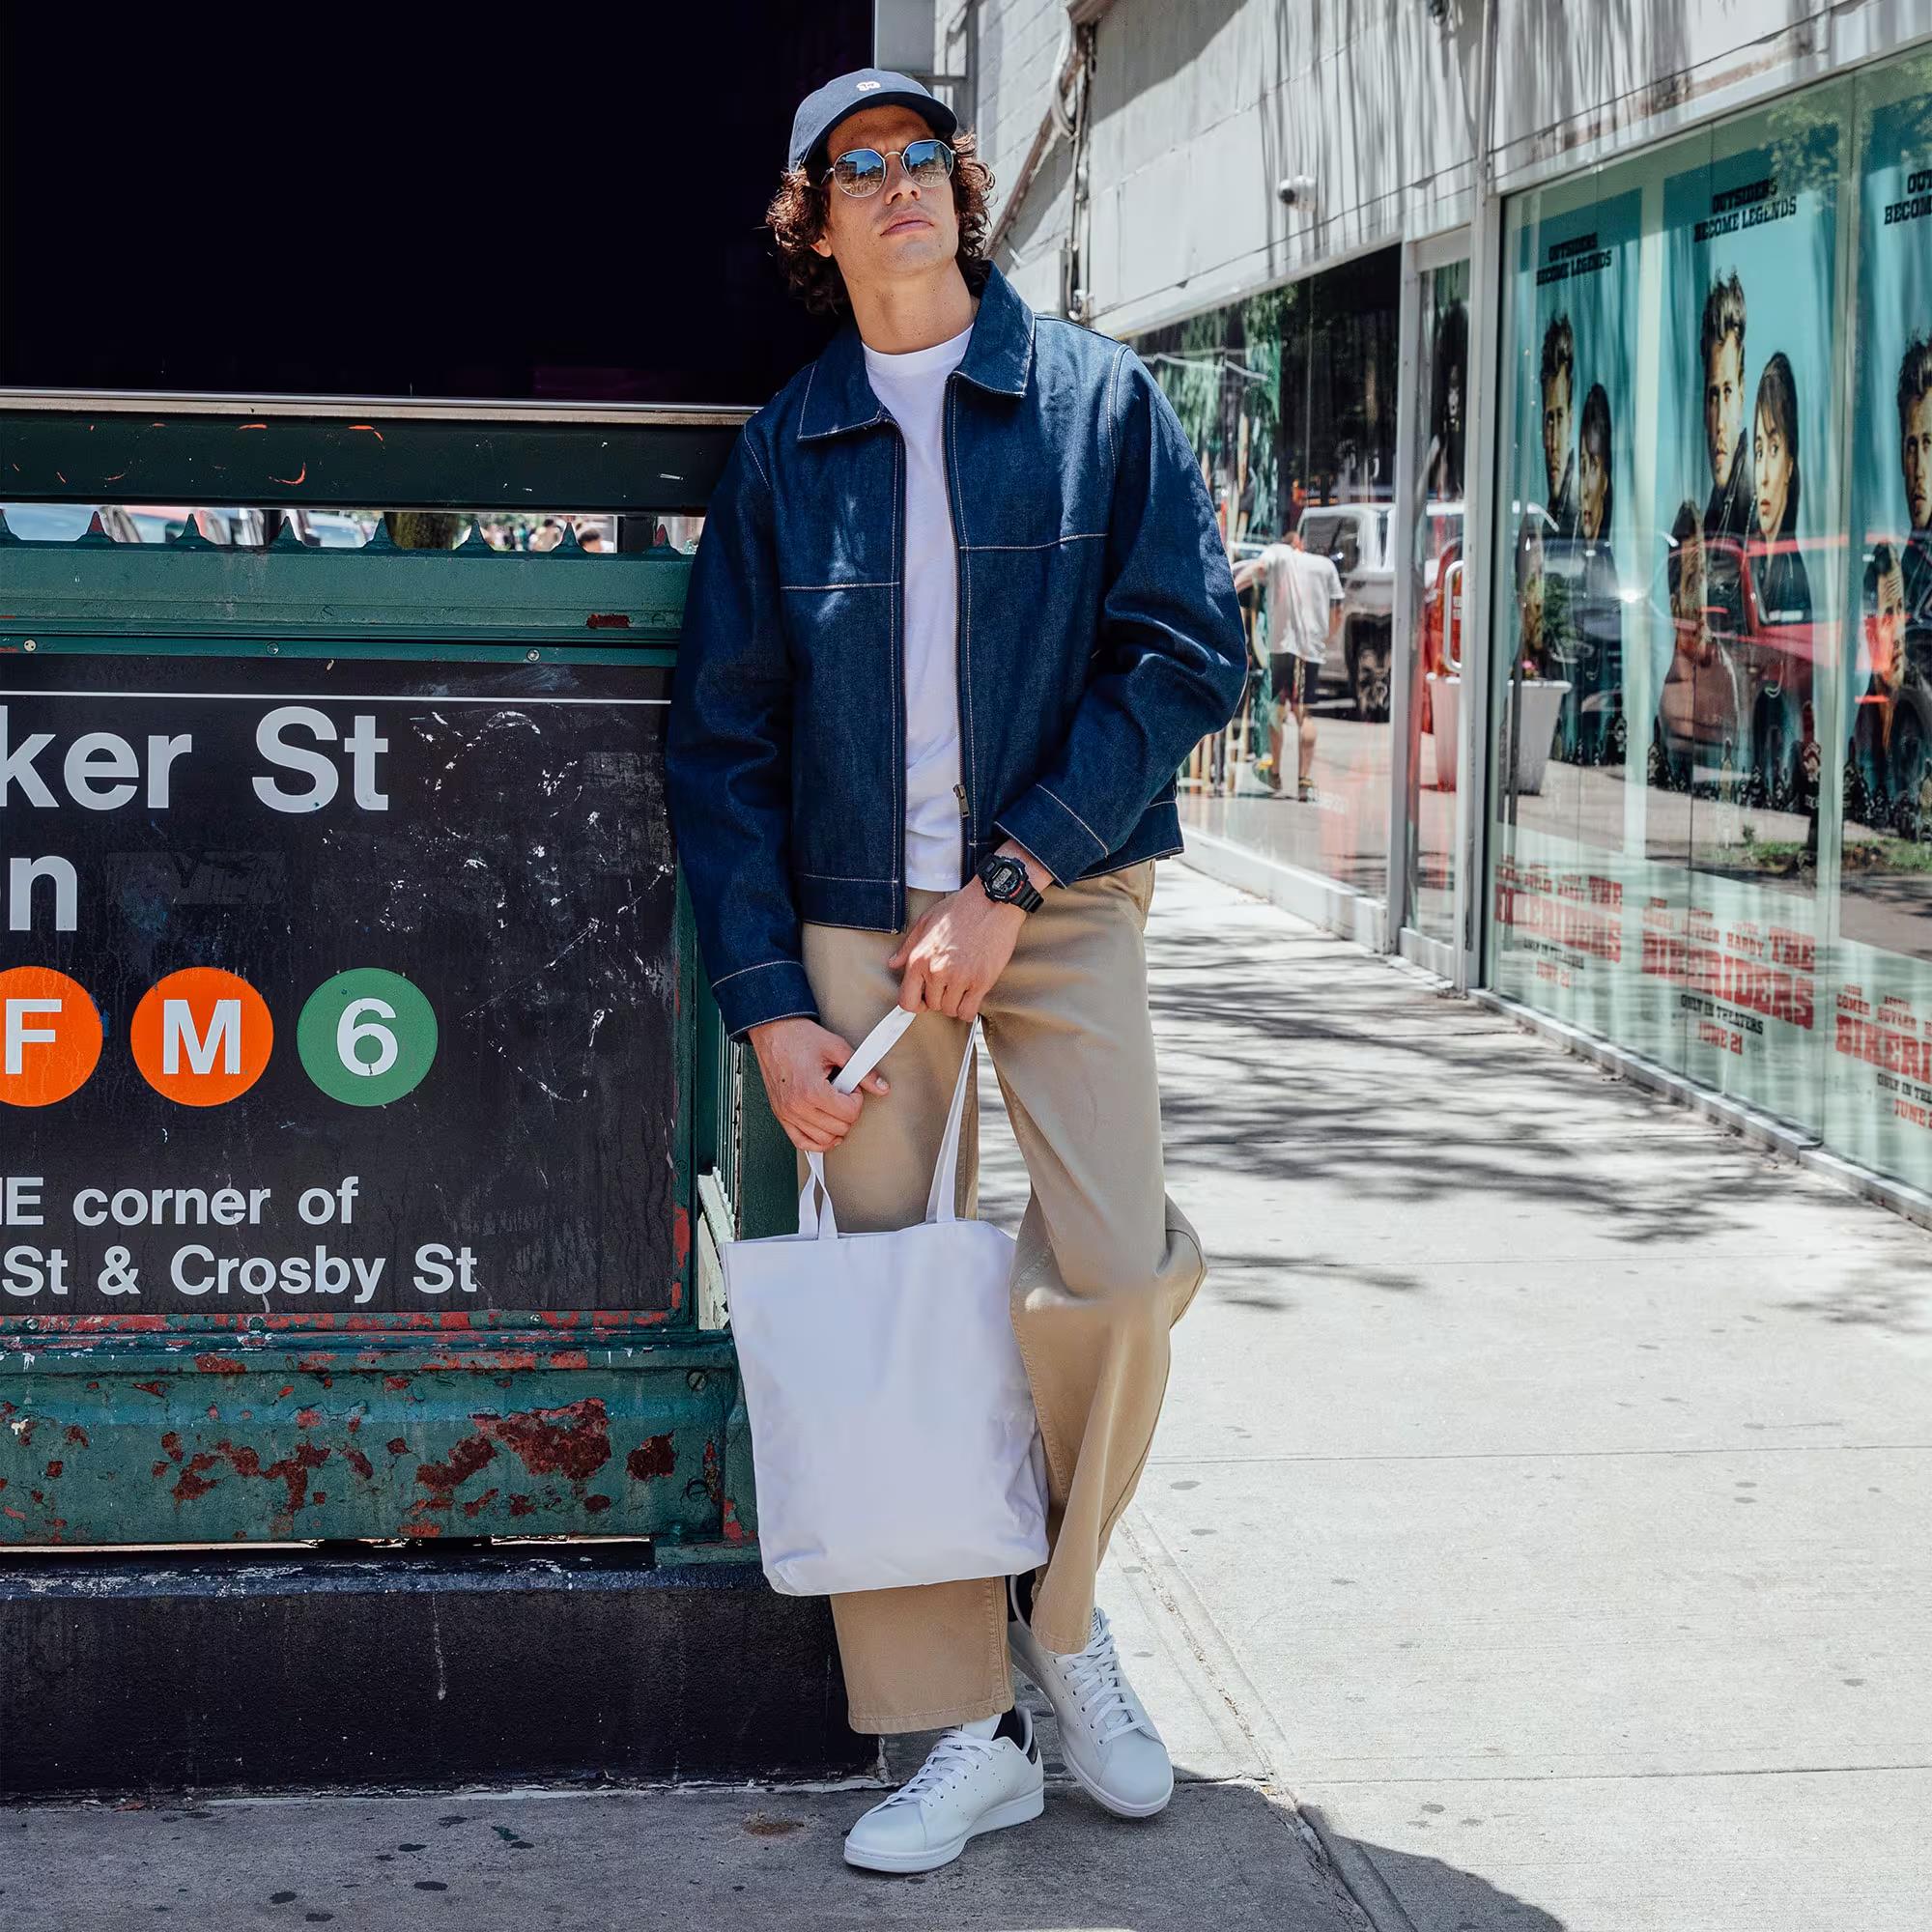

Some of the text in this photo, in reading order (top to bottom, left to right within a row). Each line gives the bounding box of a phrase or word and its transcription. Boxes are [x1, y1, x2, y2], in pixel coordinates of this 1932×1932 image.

[1693, 195, 1797, 243] BECOME LEGENDS
[0, 705, 389, 813] ker St
[1768, 926, 1816, 974] THE
[5, 997, 399, 1077] F M 6
[1704, 1000, 1715, 1017] IN
[1716, 1005, 1764, 1036] THEATERS
[1730, 1031, 1743, 1056] 21
[0, 1176, 359, 1227] E corner of
[1, 1243, 478, 1304] St & Crosby St
